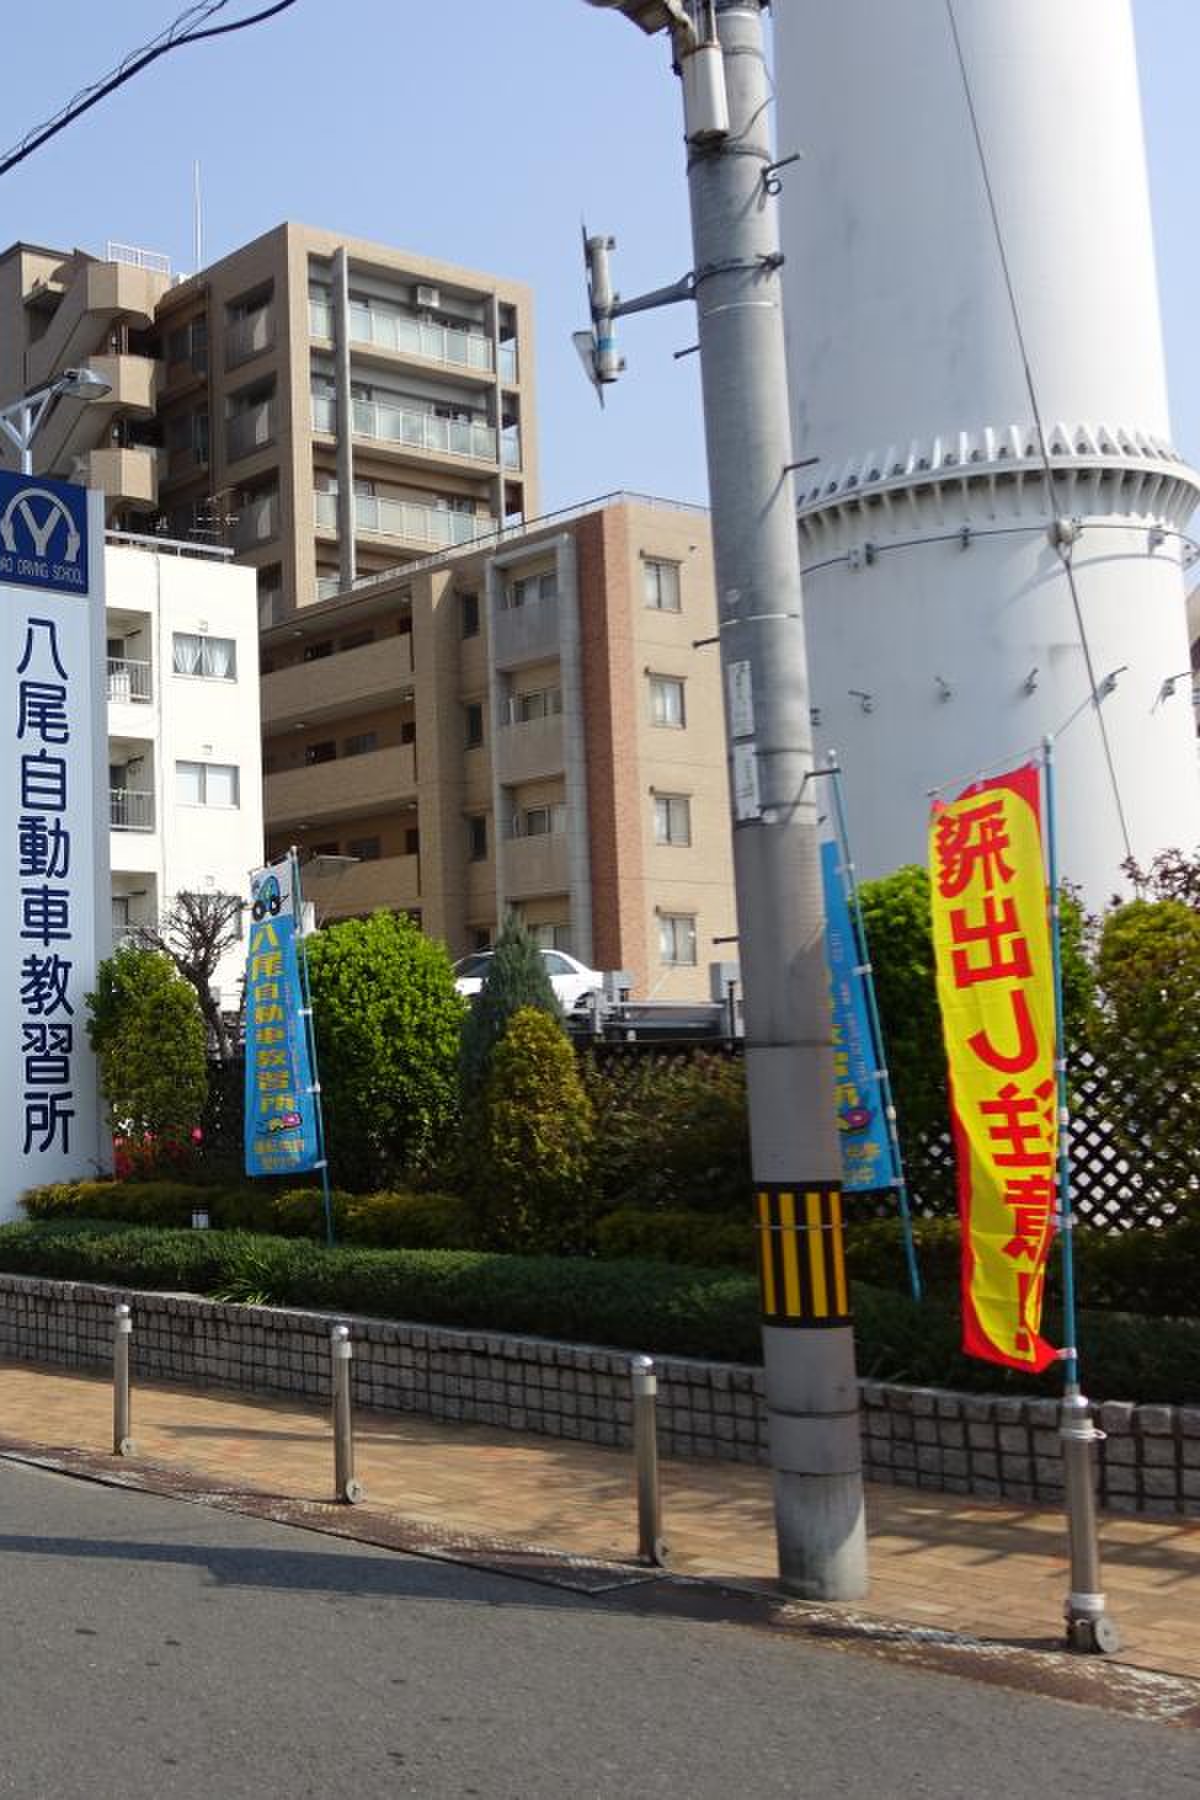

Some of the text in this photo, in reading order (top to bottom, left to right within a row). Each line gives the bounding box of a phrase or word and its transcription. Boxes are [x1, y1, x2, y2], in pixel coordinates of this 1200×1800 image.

[16, 558, 49, 578] DRIVING
[51, 564, 84, 586] SCHOOL
[16, 617, 76, 1156] 八尾自動車教習所
[251, 923, 295, 1115] 八尾自動車教習所
